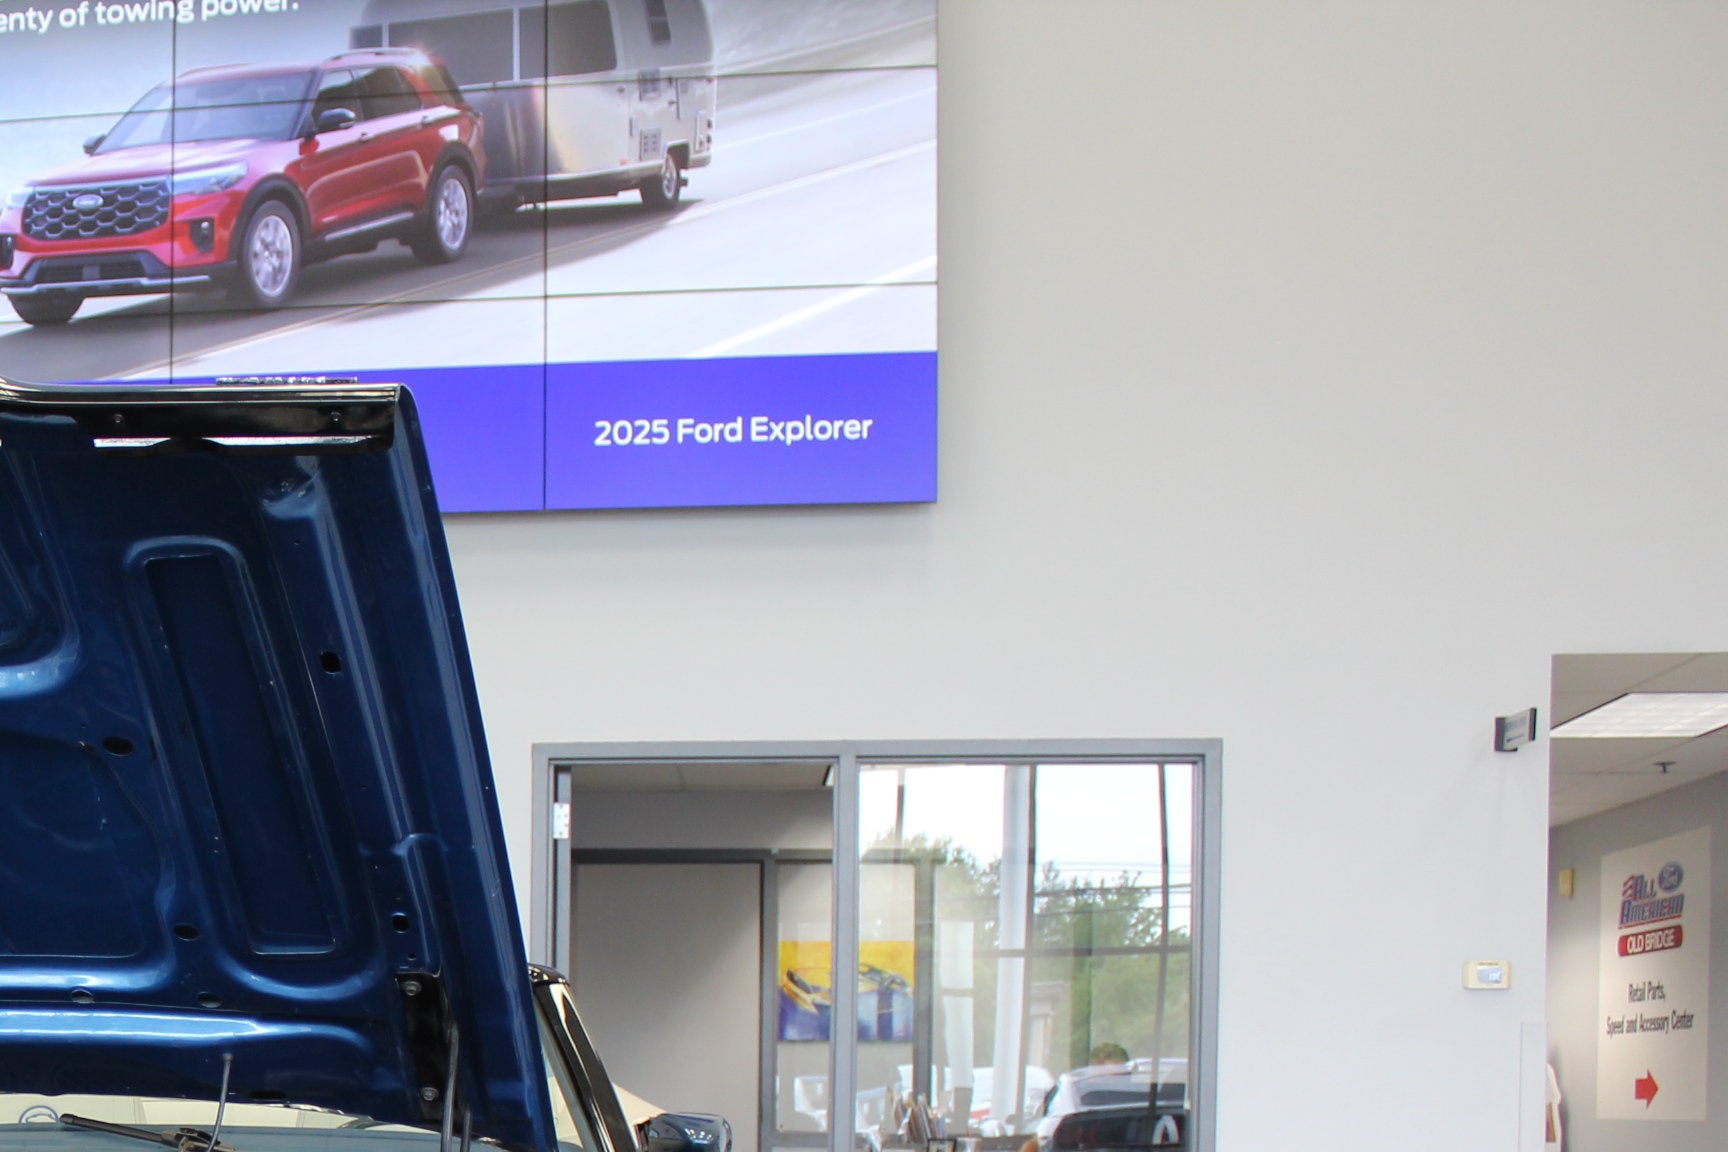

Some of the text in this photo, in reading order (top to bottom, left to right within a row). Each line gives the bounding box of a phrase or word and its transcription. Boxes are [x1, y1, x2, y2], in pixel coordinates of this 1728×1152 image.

[58, 0, 89, 28] of
[94, 0, 194, 25] towing
[201, 0, 299, 21] power.
[594, 414, 873, 446] 2025 Ford Explorer
[1627, 929, 1675, 954] OLD BRIDGE
[1606, 1015, 1624, 1039] Speed
[1626, 1013, 1637, 1034] and
[1672, 1009, 1694, 1030] Center
